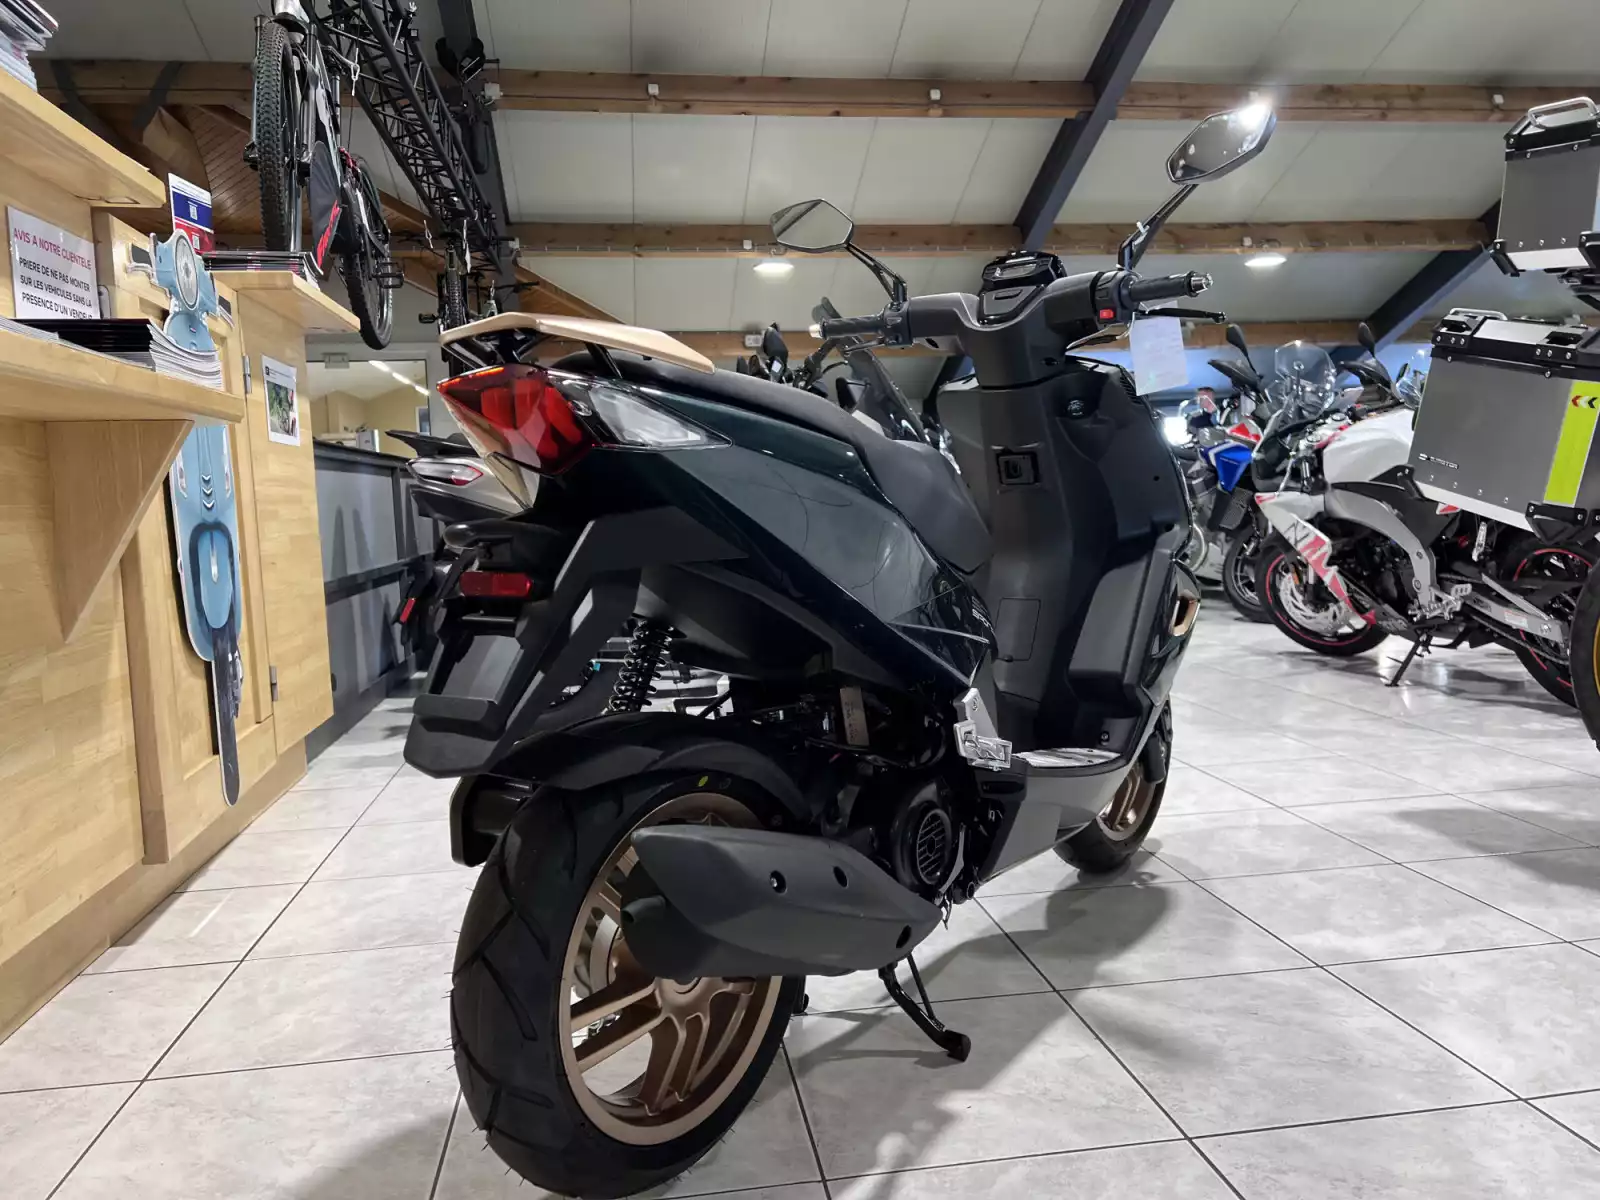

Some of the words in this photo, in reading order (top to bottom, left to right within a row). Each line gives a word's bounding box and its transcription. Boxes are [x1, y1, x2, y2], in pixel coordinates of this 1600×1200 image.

[14, 228, 30, 243] AVIS
[32, 235, 38, 247] A
[39, 238, 60, 256] NOTRE
[61, 248, 91, 269] CLIENTELE
[19, 257, 40, 273] PRIERE
[41, 265, 49, 276] DE
[50, 268, 58, 279] NE
[59, 272, 69, 284] PAS
[70, 276, 90, 292] MONTER
[20, 275, 32, 286] SUR
[34, 278, 43, 290] LES
[44, 283, 72, 301] VEHICULES
[73, 293, 85, 305] SANS
[85, 298, 92, 308] LA
[22, 292, 53, 311] PRESENCE
[54, 301, 68, 314] D'UN
